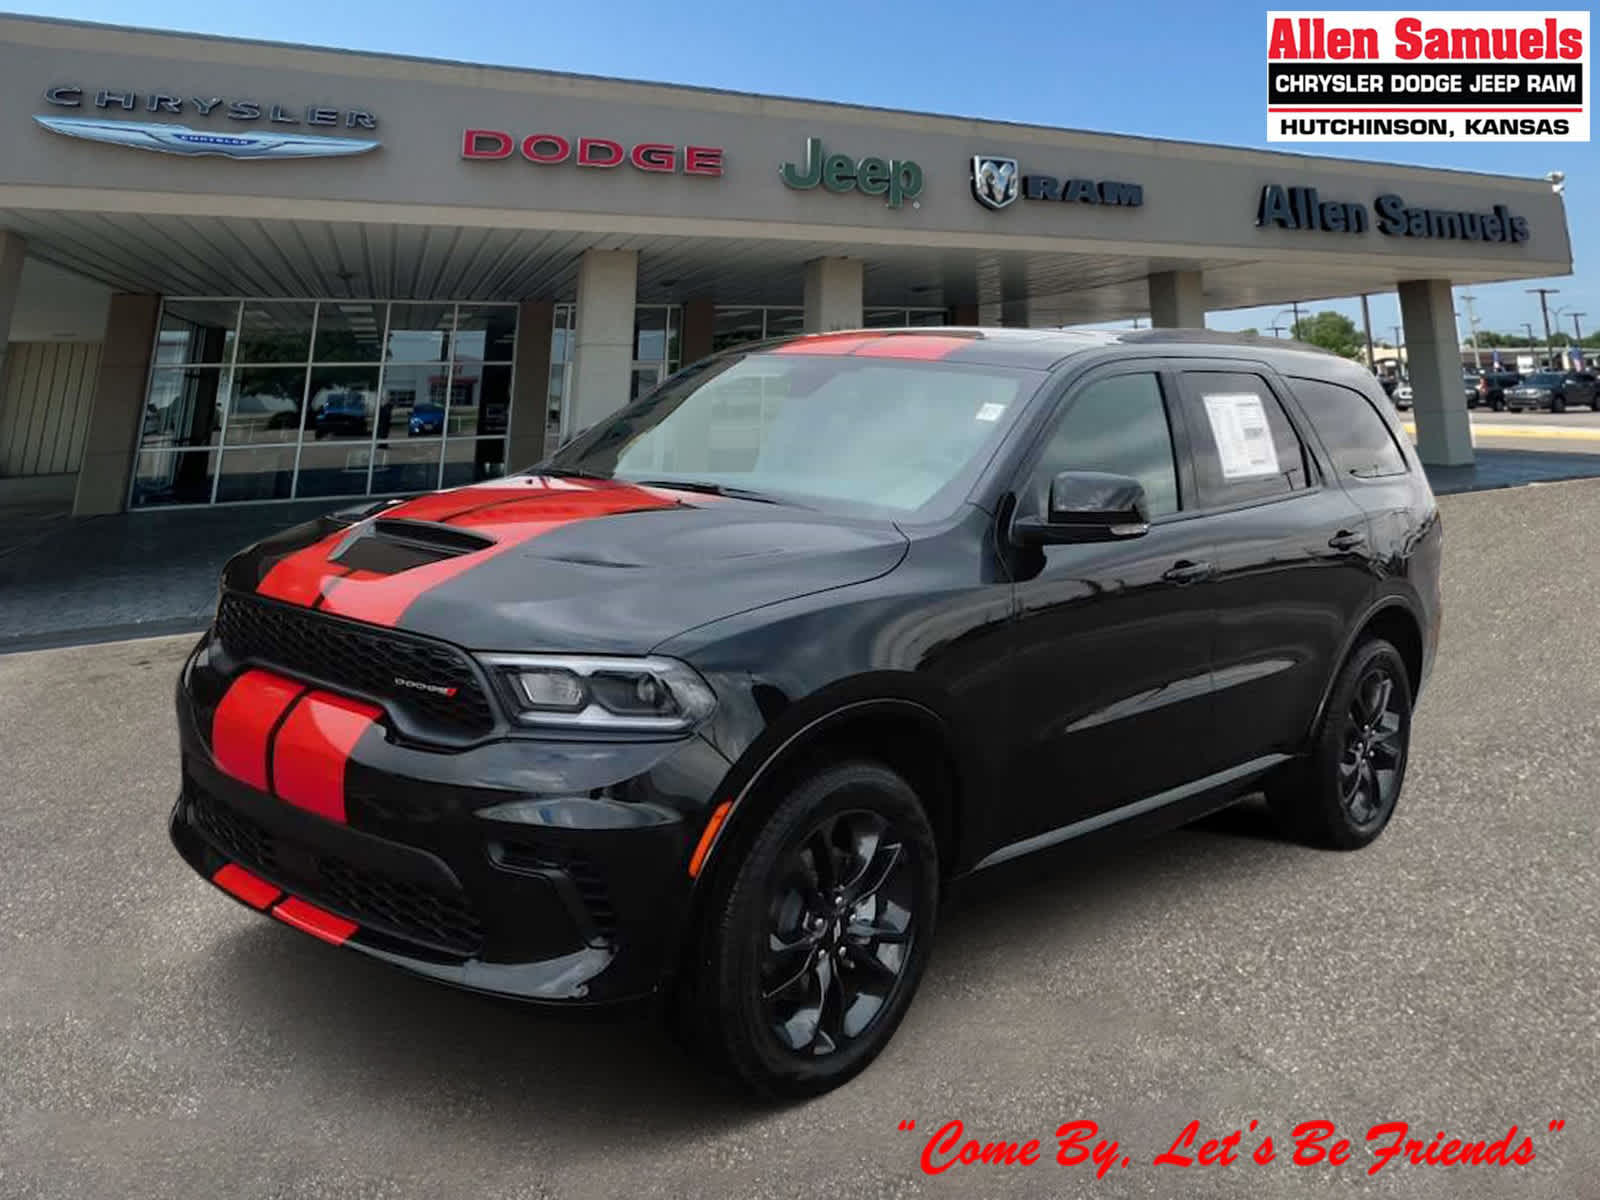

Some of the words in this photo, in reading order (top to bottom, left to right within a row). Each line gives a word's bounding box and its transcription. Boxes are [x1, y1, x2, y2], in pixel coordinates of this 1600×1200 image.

[44, 86, 378, 129] CHRYSLER
[461, 128, 725, 177] DODGE
[779, 137, 923, 209] Jeep
[1023, 175, 1144, 208] RAM
[1256, 184, 1369, 233] Allen
[1374, 193, 1531, 242] Samuels
[394, 677, 447, 694] DODGE
